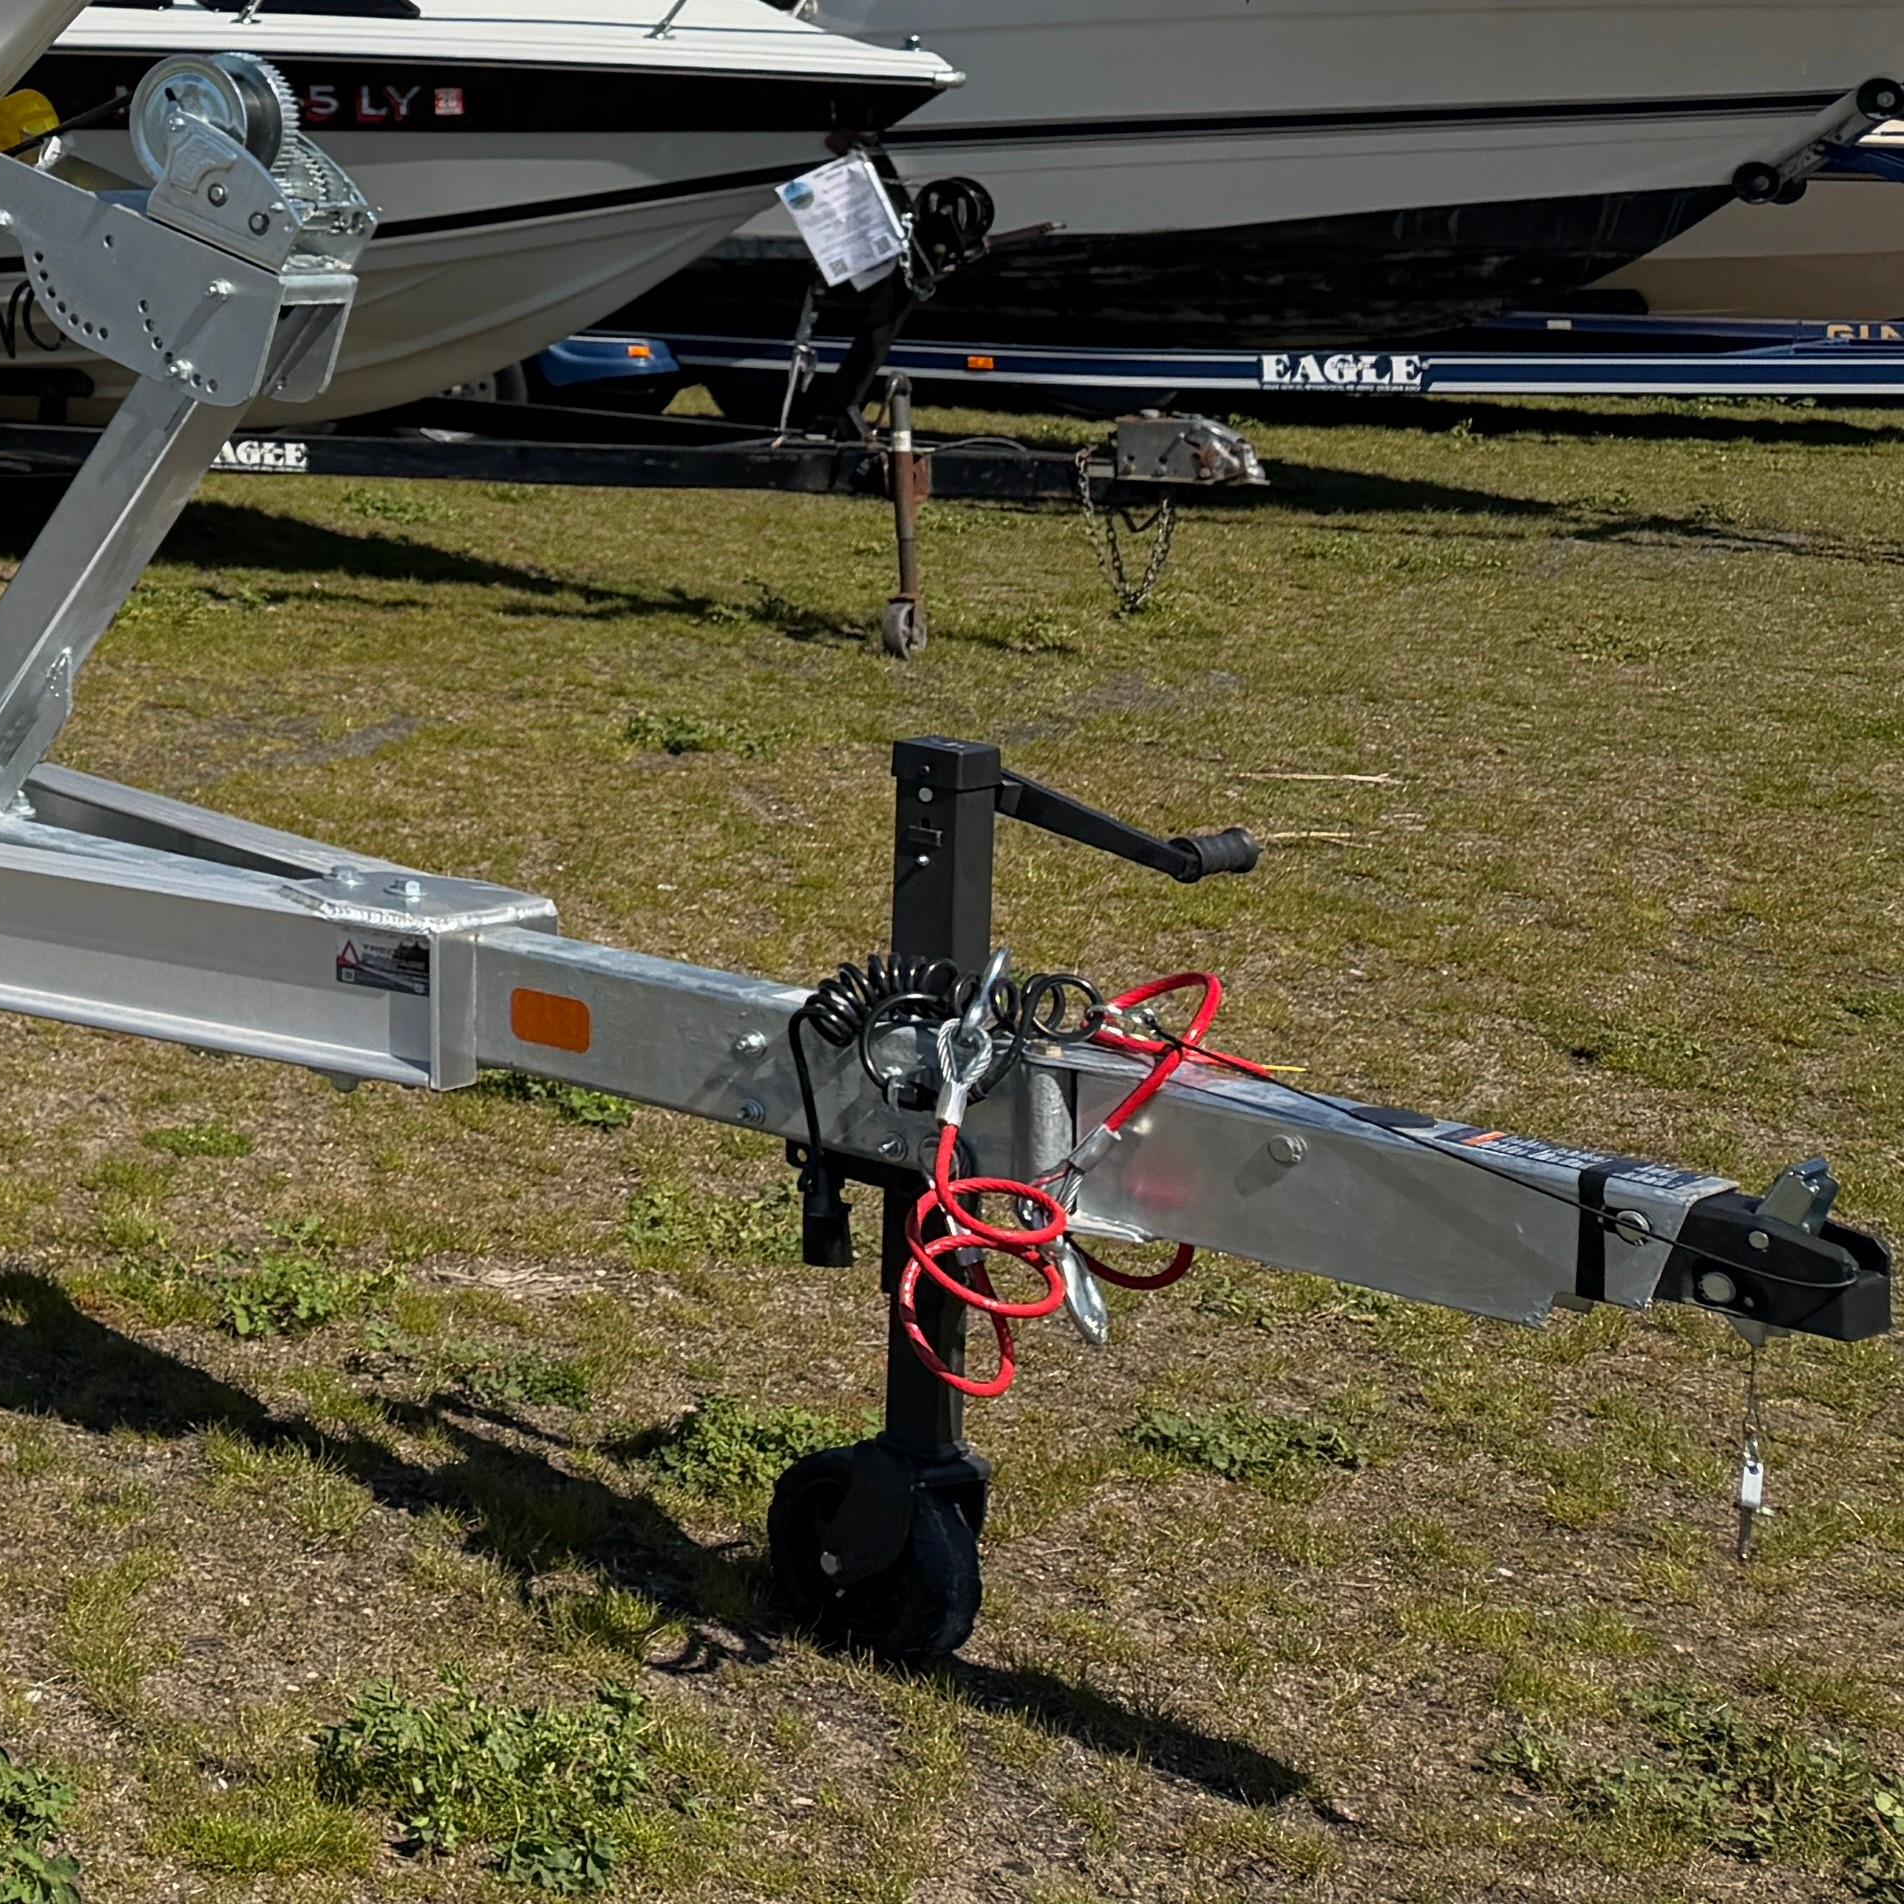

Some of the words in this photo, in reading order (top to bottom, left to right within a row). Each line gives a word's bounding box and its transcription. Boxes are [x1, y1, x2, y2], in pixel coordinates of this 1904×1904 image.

[357, 84, 422, 121] LY
[1261, 353, 1424, 385] EAGLE
[213, 440, 309, 468] AGLE
